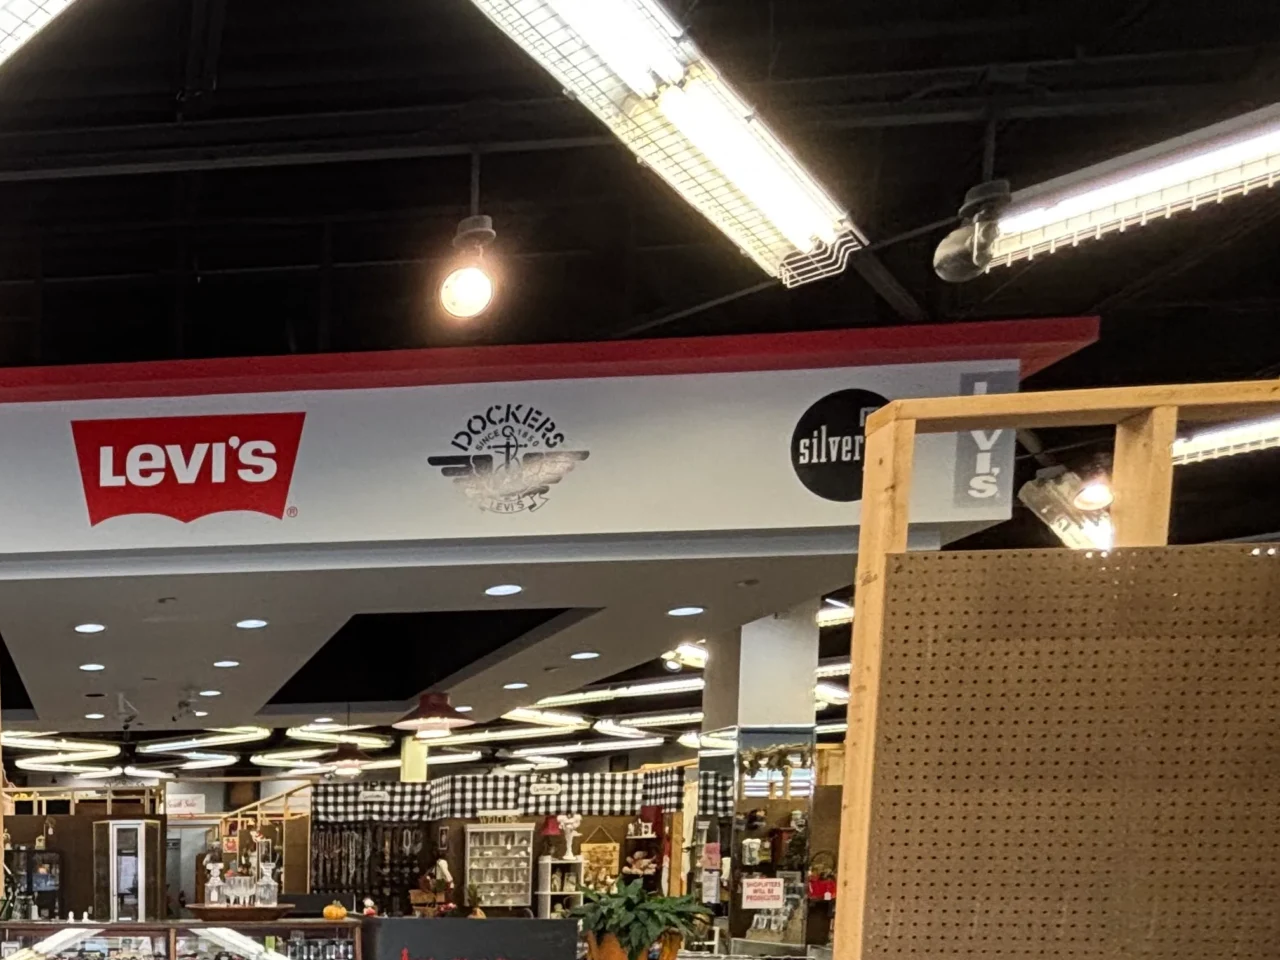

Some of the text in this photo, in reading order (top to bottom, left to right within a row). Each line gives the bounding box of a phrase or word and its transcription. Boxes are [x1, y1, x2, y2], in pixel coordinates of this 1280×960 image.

[451, 404, 564, 451] DOCKERS
[475, 429, 540, 451] SINCE 1850
[799, 424, 864, 464] silver
